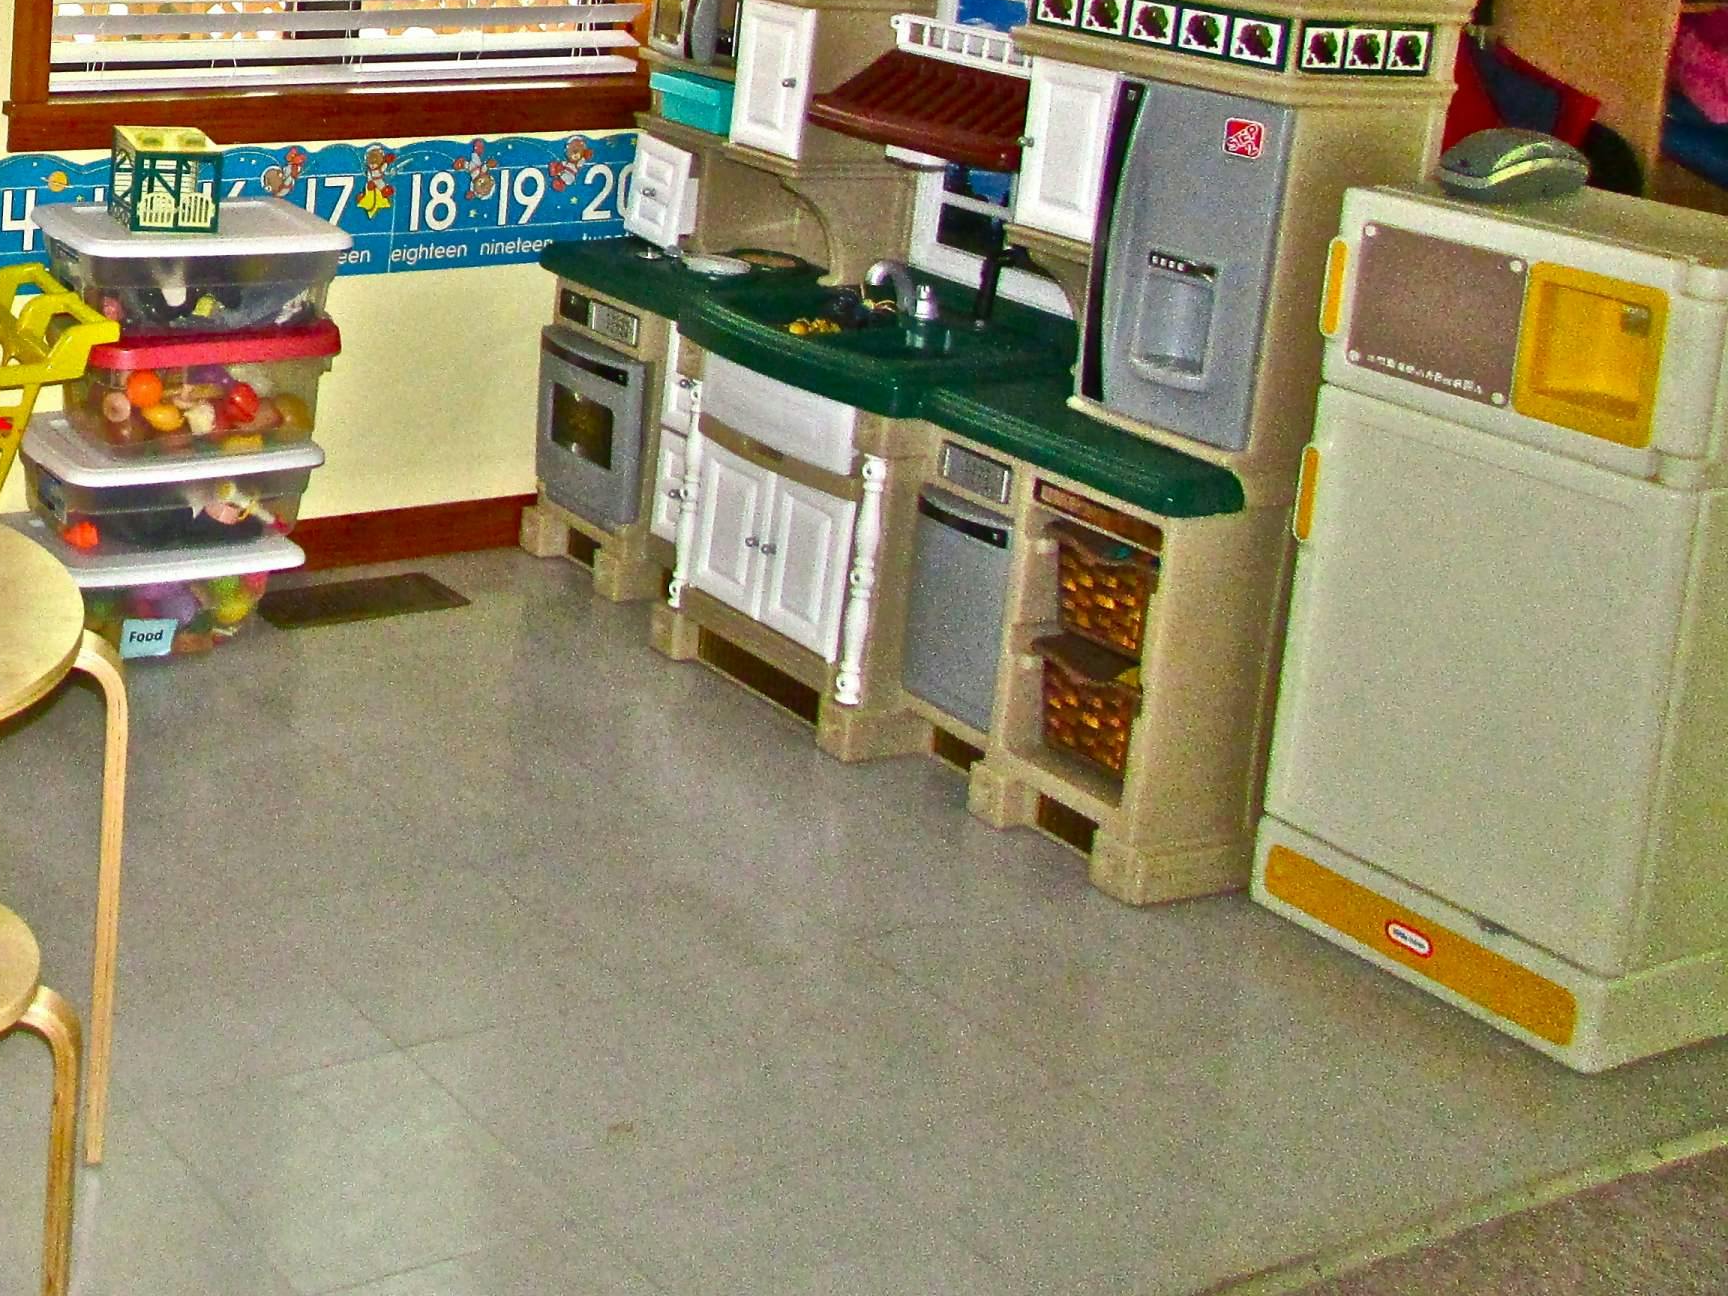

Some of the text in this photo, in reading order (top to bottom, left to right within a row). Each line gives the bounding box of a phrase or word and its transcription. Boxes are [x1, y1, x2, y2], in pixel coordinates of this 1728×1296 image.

[1227, 124, 1258, 151] STEP
[1247, 141, 1259, 156] 2
[305, 176, 354, 227] 17
[409, 172, 457, 232] 18
[497, 167, 546, 226] 19
[391, 243, 468, 264] eighteen
[480, 236, 553, 256] nineteen
[129, 629, 163, 643] Food
